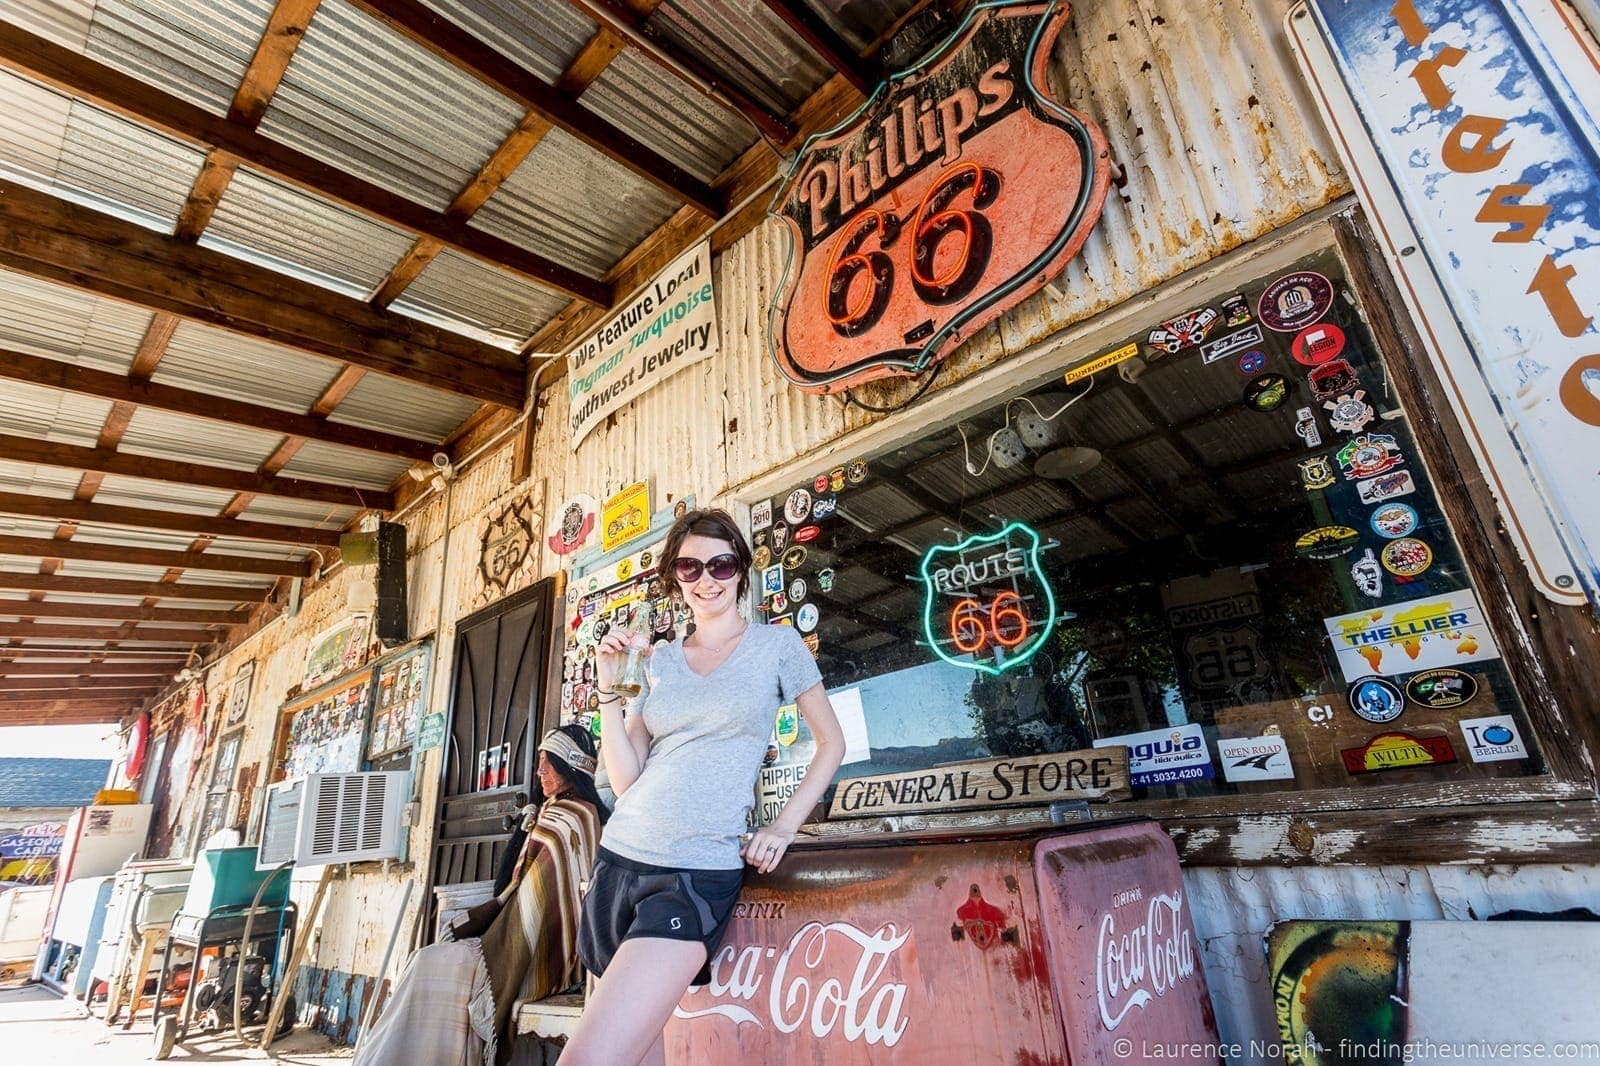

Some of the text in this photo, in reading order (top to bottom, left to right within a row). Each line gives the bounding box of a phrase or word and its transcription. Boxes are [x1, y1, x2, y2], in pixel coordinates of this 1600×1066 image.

[799, 59, 1014, 238] Phillips
[822, 161, 1002, 339] 66
[574, 253, 700, 370] We Feature Local
[628, 283, 713, 353] Turquoise
[638, 321, 712, 381] Jewelry
[753, 510, 770, 525] 2010
[934, 548, 1026, 593] ROUTE
[951, 591, 1028, 652] 66
[1346, 613, 1470, 646] THELLIER
[1224, 747, 1250, 757] OPEN
[1251, 744, 1282, 754] ROAD
[1466, 726, 1487, 749] I
[1475, 744, 1520, 757] BERLIN
[841, 757, 1114, 811] GENERAL STORE
[1140, 776, 1151, 784] 41
[1153, 768, 1203, 782] 3032.4200
[733, 902, 787, 919] RINK
[1113, 887, 1143, 909] DRINK
[674, 920, 912, 1047] ca-Cola
[1096, 888, 1194, 1031] Coca-Cola
